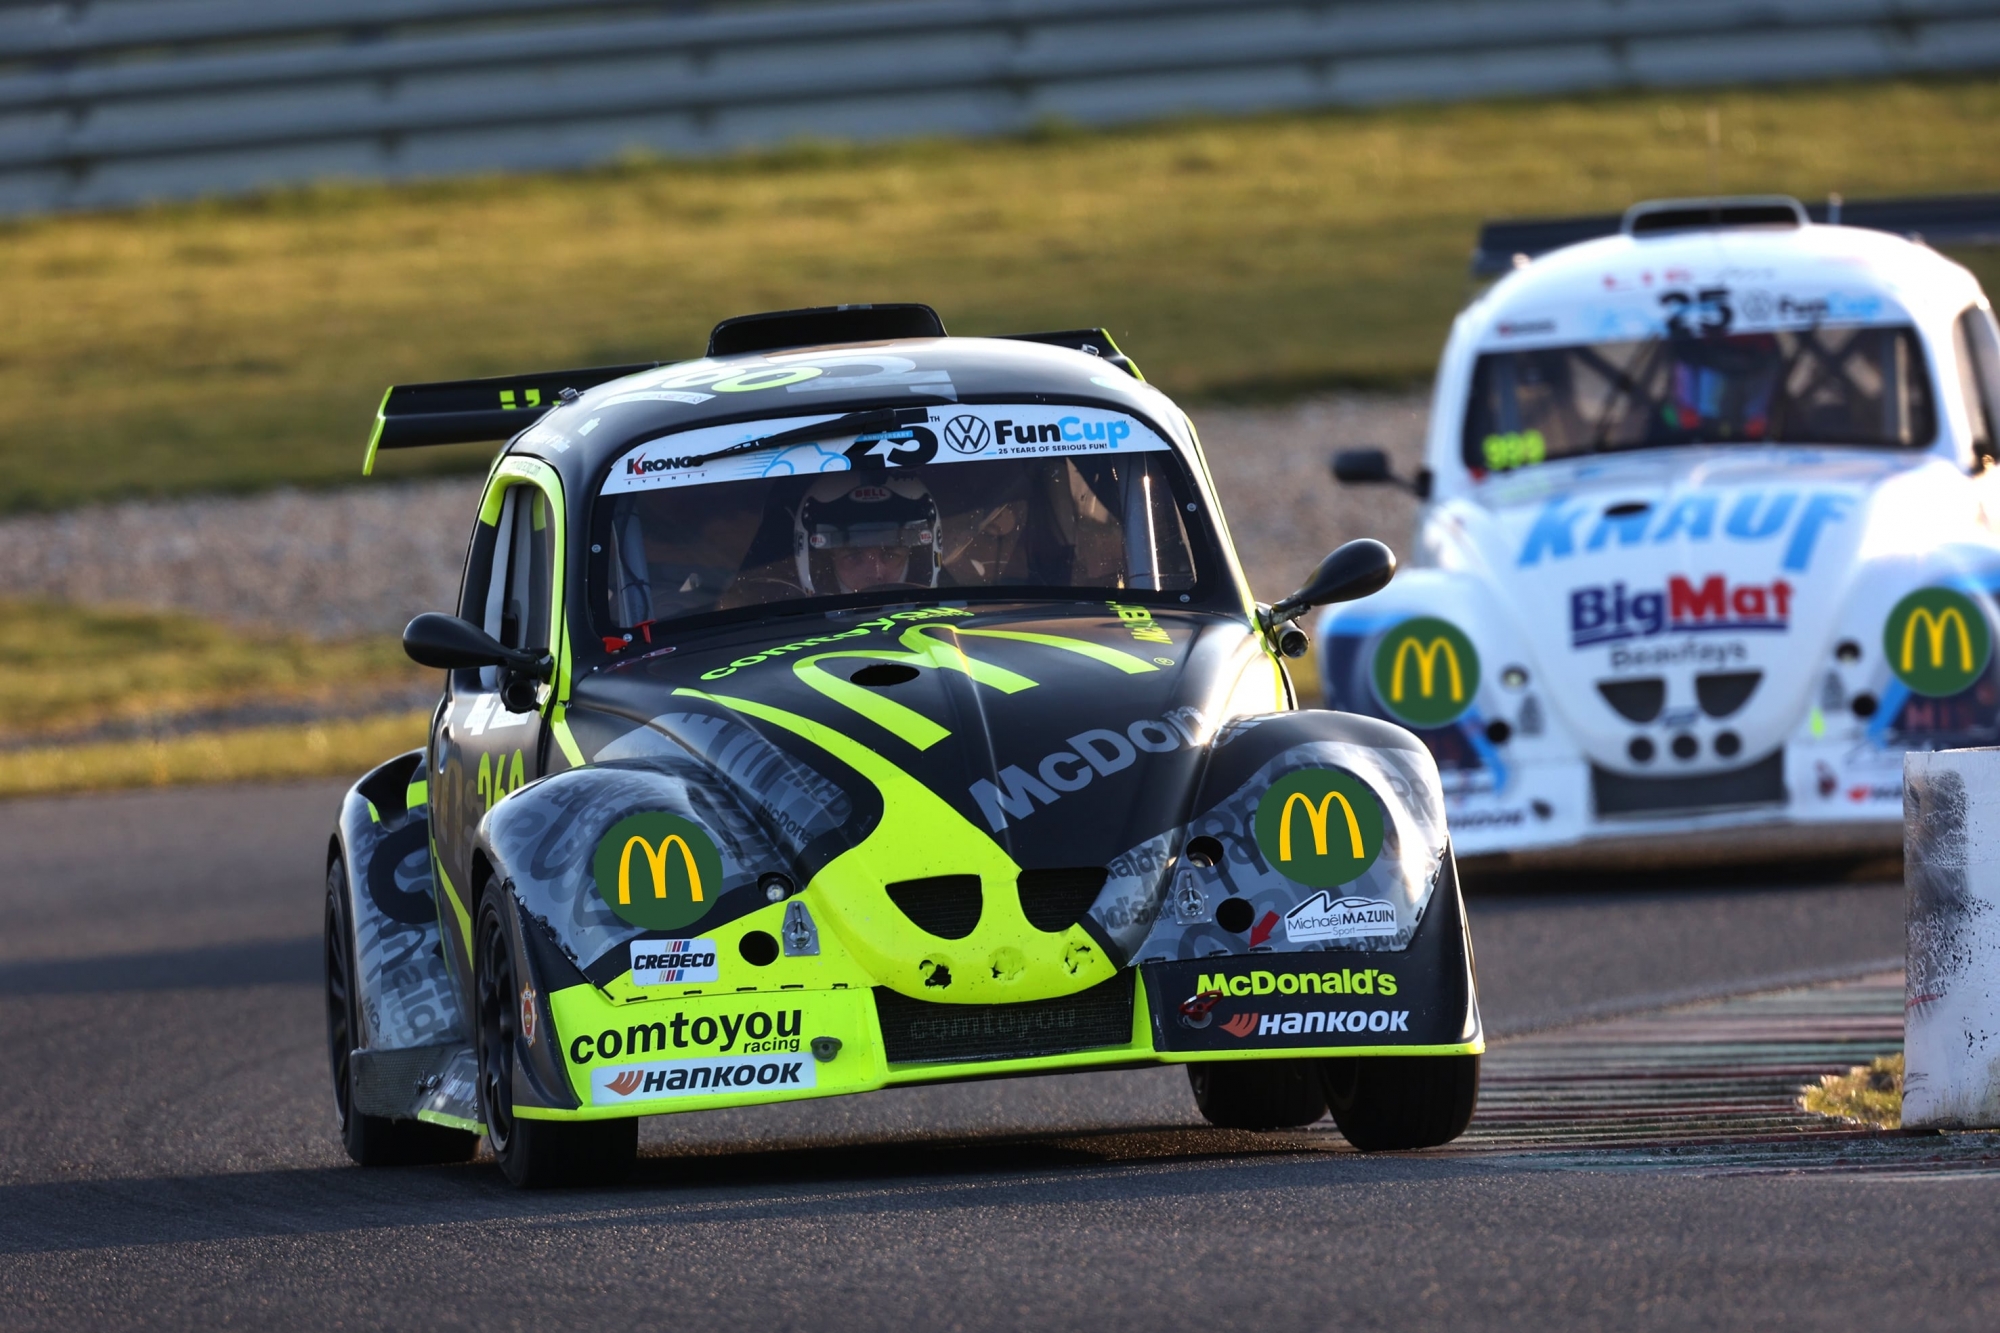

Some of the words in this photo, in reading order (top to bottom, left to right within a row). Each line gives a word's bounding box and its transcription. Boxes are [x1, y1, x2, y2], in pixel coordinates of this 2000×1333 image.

[1657, 289, 1735, 338] 25
[994, 416, 1131, 448] FunCup
[998, 447, 1009, 455] 25
[1010, 445, 1037, 455] YEARS
[1038, 443, 1050, 453] OF
[1052, 442, 1087, 452] SERIOUS
[1089, 442, 1108, 450] FUN!
[626, 452, 705, 476] KRONO
[854, 488, 887, 498] BELL
[1516, 490, 1850, 572] KNAUF
[1569, 575, 1792, 637] BigMat
[700, 606, 968, 681] comtoyou
[1342, 909, 1395, 925] MAZUIN
[1332, 927, 1356, 936] Sport
[633, 952, 716, 971] CREDECO
[1197, 968, 1398, 998] McDonald's
[570, 1009, 802, 1065] comtoyou
[743, 1036, 801, 1054] racing
